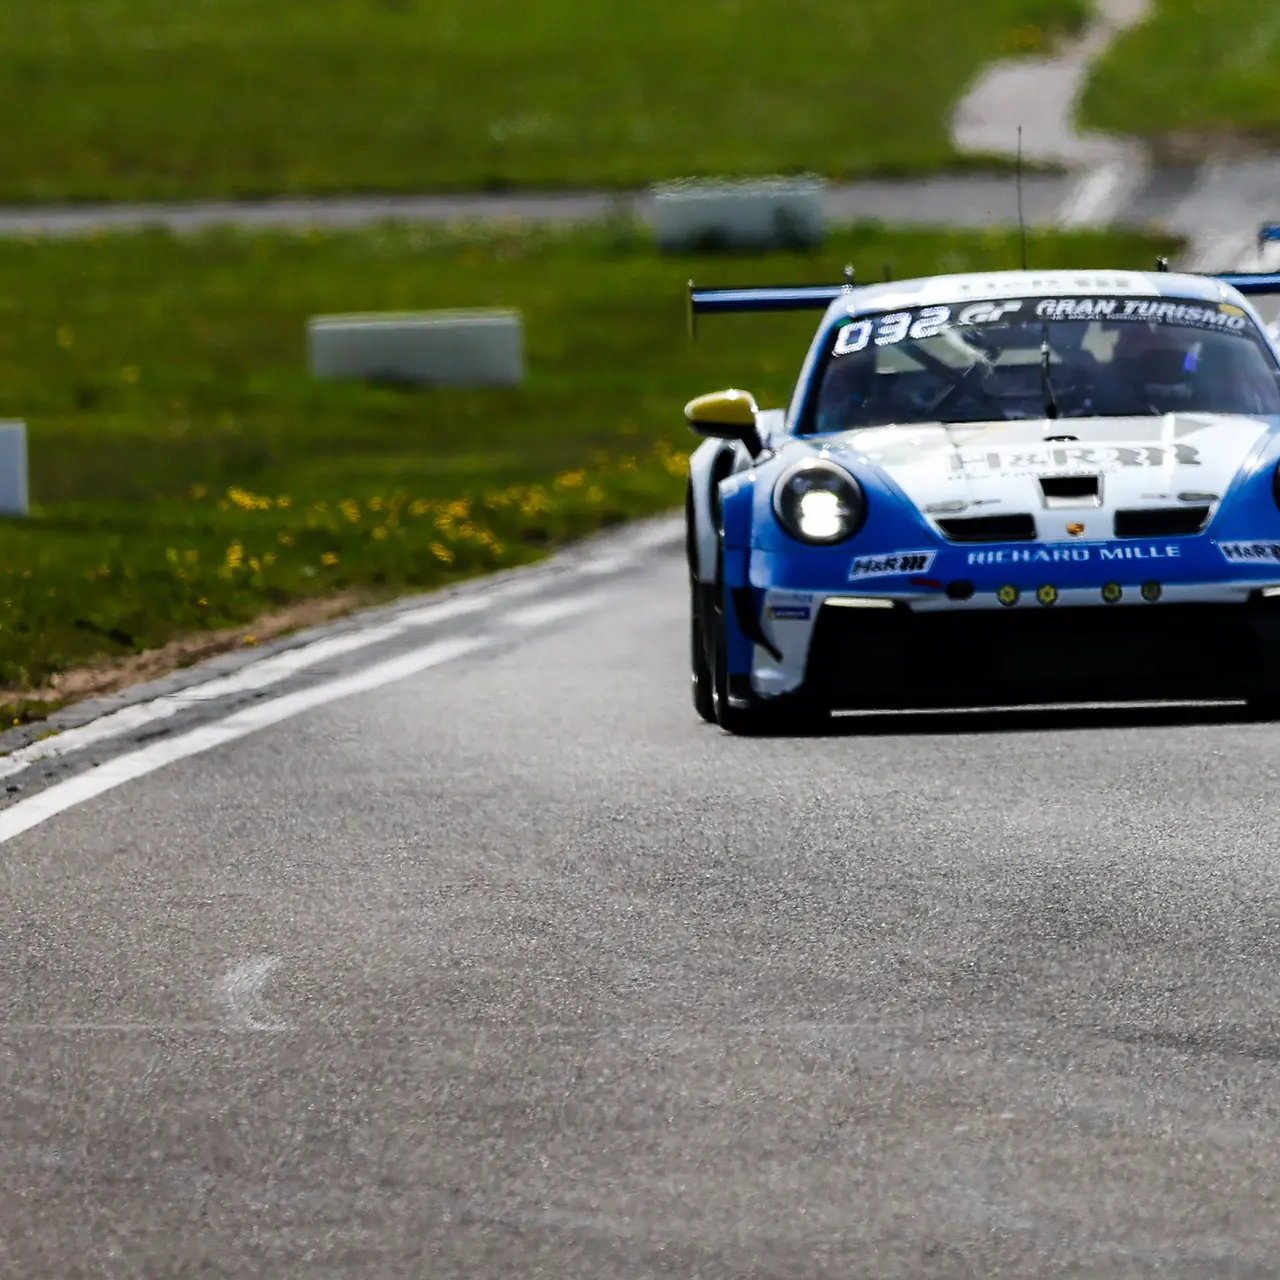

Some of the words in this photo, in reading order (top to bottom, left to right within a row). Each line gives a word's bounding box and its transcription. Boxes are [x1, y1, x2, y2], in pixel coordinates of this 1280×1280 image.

[1035, 298, 1117, 317] GRAN
[1123, 298, 1246, 330] TURISMO
[833, 305, 951, 357] 032
[966, 548, 1091, 565] RICHARD
[1099, 544, 1181, 561] MILLE
